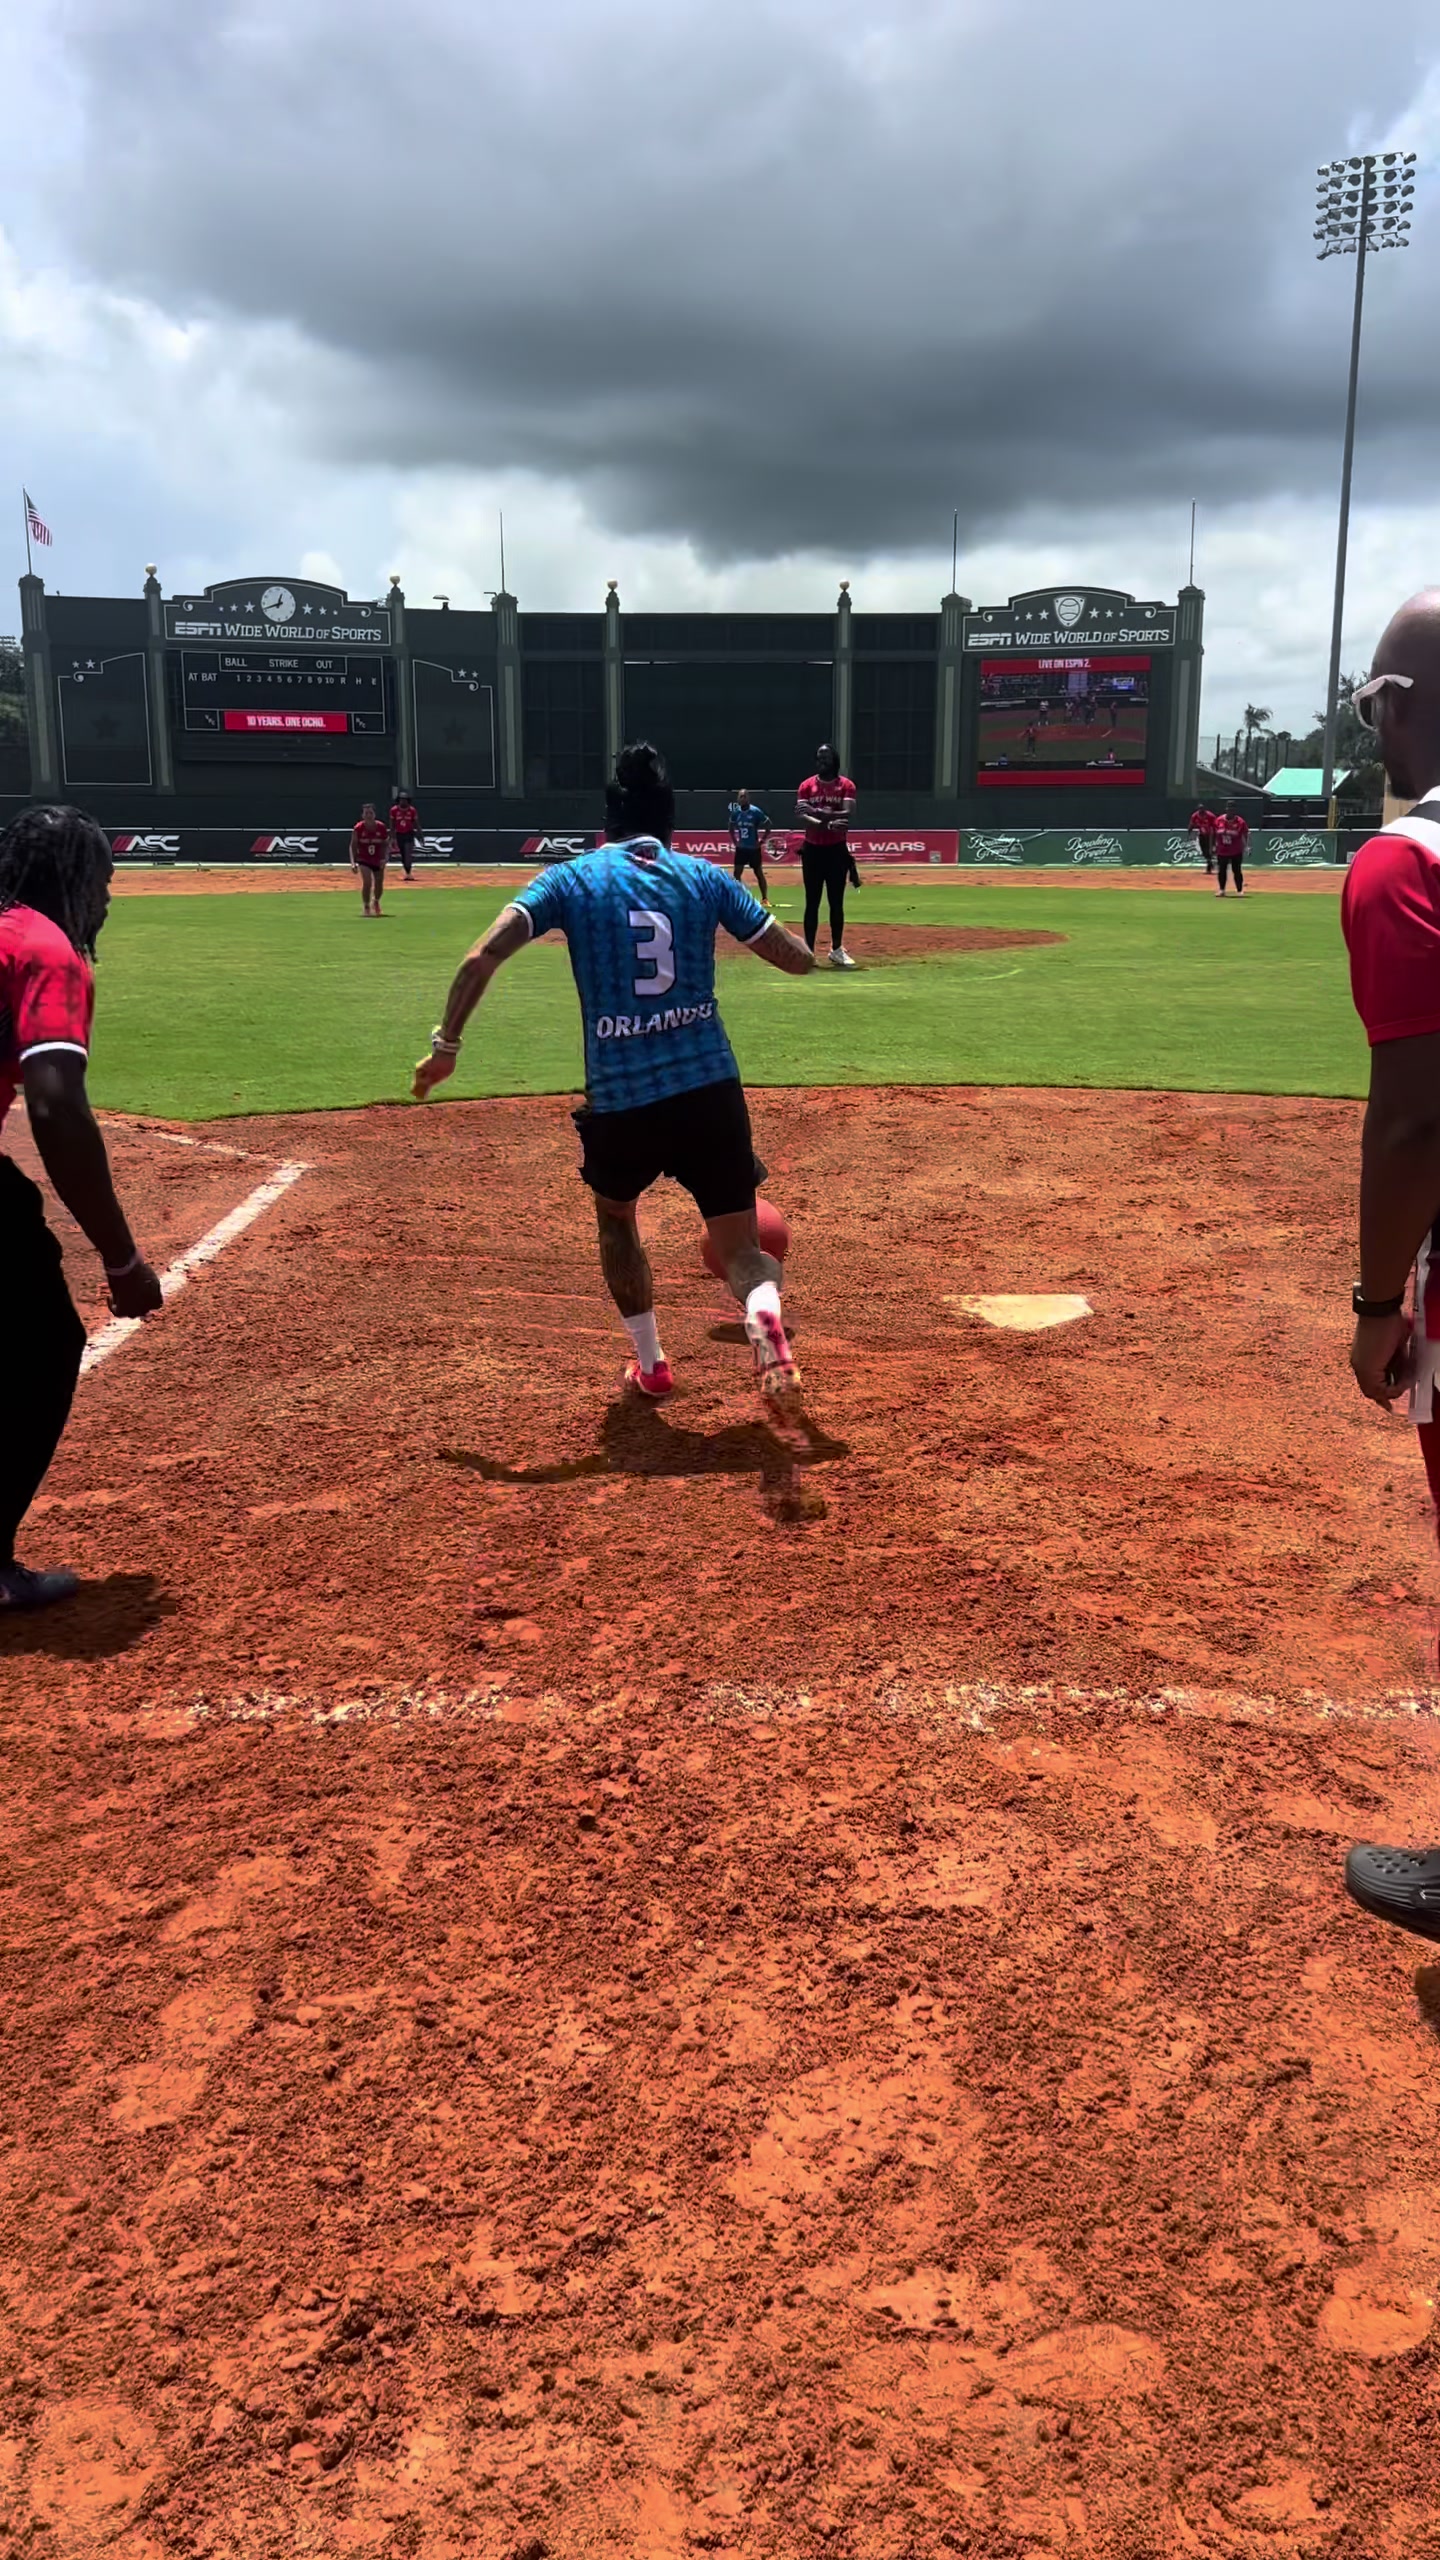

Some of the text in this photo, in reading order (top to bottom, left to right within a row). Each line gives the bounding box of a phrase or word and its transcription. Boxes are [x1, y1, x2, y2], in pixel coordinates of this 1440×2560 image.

[175, 621, 382, 641] ESPN WIDE WORLD OF SPORTS
[968, 629, 1169, 647] ESPN WIDE WORLD OF SPORTS
[224, 657, 333, 669] BALL STRIKE OUT
[1038, 660, 1055, 669] LIVE
[1053, 660, 1064, 669] ON
[1065, 659, 1083, 669] ESPN
[188, 672, 218, 682] AT BAT
[256, 675, 262, 683] 3
[266, 675, 273, 683] 4
[276, 675, 283, 683] 5
[286, 676, 293, 684] 6
[307, 676, 313, 684] 8
[317, 677, 323, 685] 9
[340, 677, 346, 685] R
[355, 677, 362, 685] H
[371, 677, 377, 686] E
[246, 715, 257, 726] 10
[256, 715, 285, 727] YEARS.
[284, 716, 302, 727] ONE
[740, 828, 749, 839] 12
[125, 835, 180, 852] ASC
[266, 836, 319, 852] ASC
[535, 837, 585, 853] ASC
[868, 842, 926, 852] WARS
[1064, 834, 1114, 851] Bowling
[1265, 833, 1317, 851] Bowling
[1072, 847, 1107, 863] Green
[1272, 848, 1310, 864] Green
[628, 909, 676, 995] 3
[596, 1002, 713, 1039] ORLANDO
